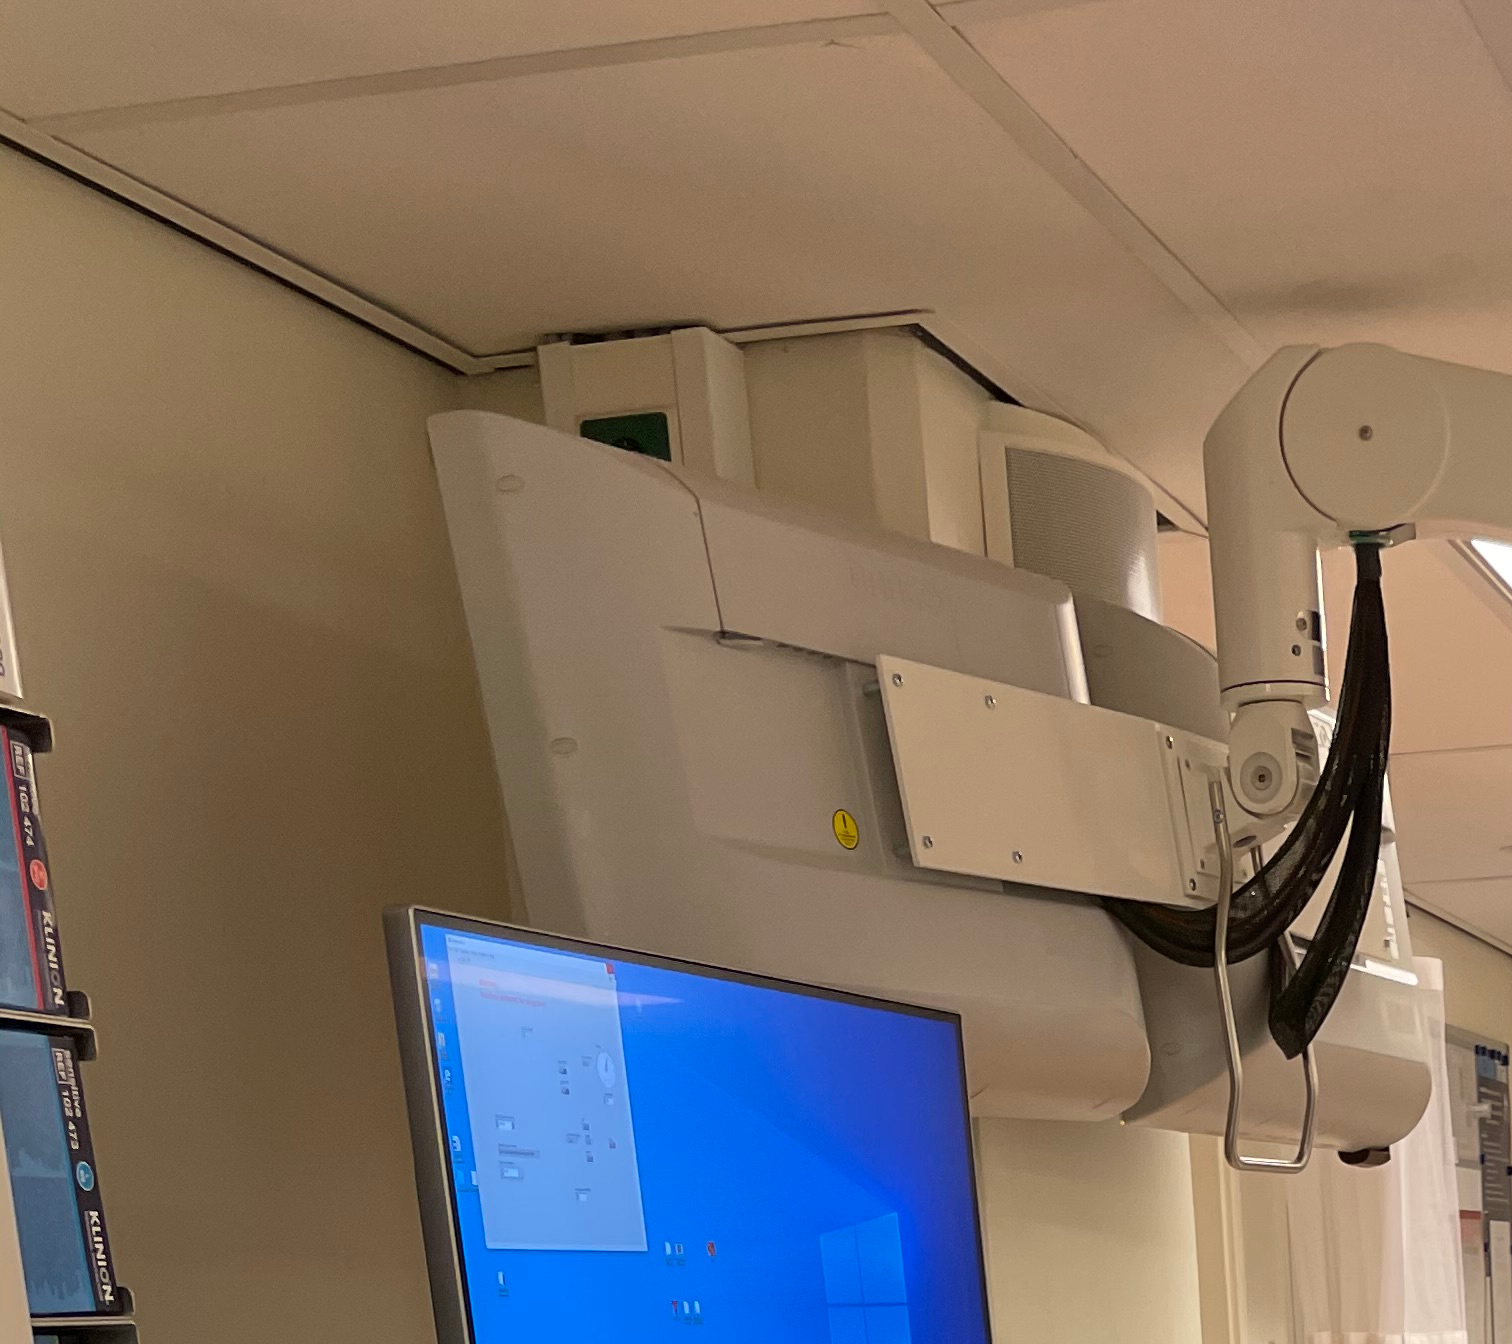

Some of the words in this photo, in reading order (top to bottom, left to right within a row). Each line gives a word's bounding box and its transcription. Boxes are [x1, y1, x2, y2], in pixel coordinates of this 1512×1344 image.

[42, 911, 65, 1005] KLINION
[62, 1090, 74, 1117] 102
[89, 1211, 115, 1301] KLINION
